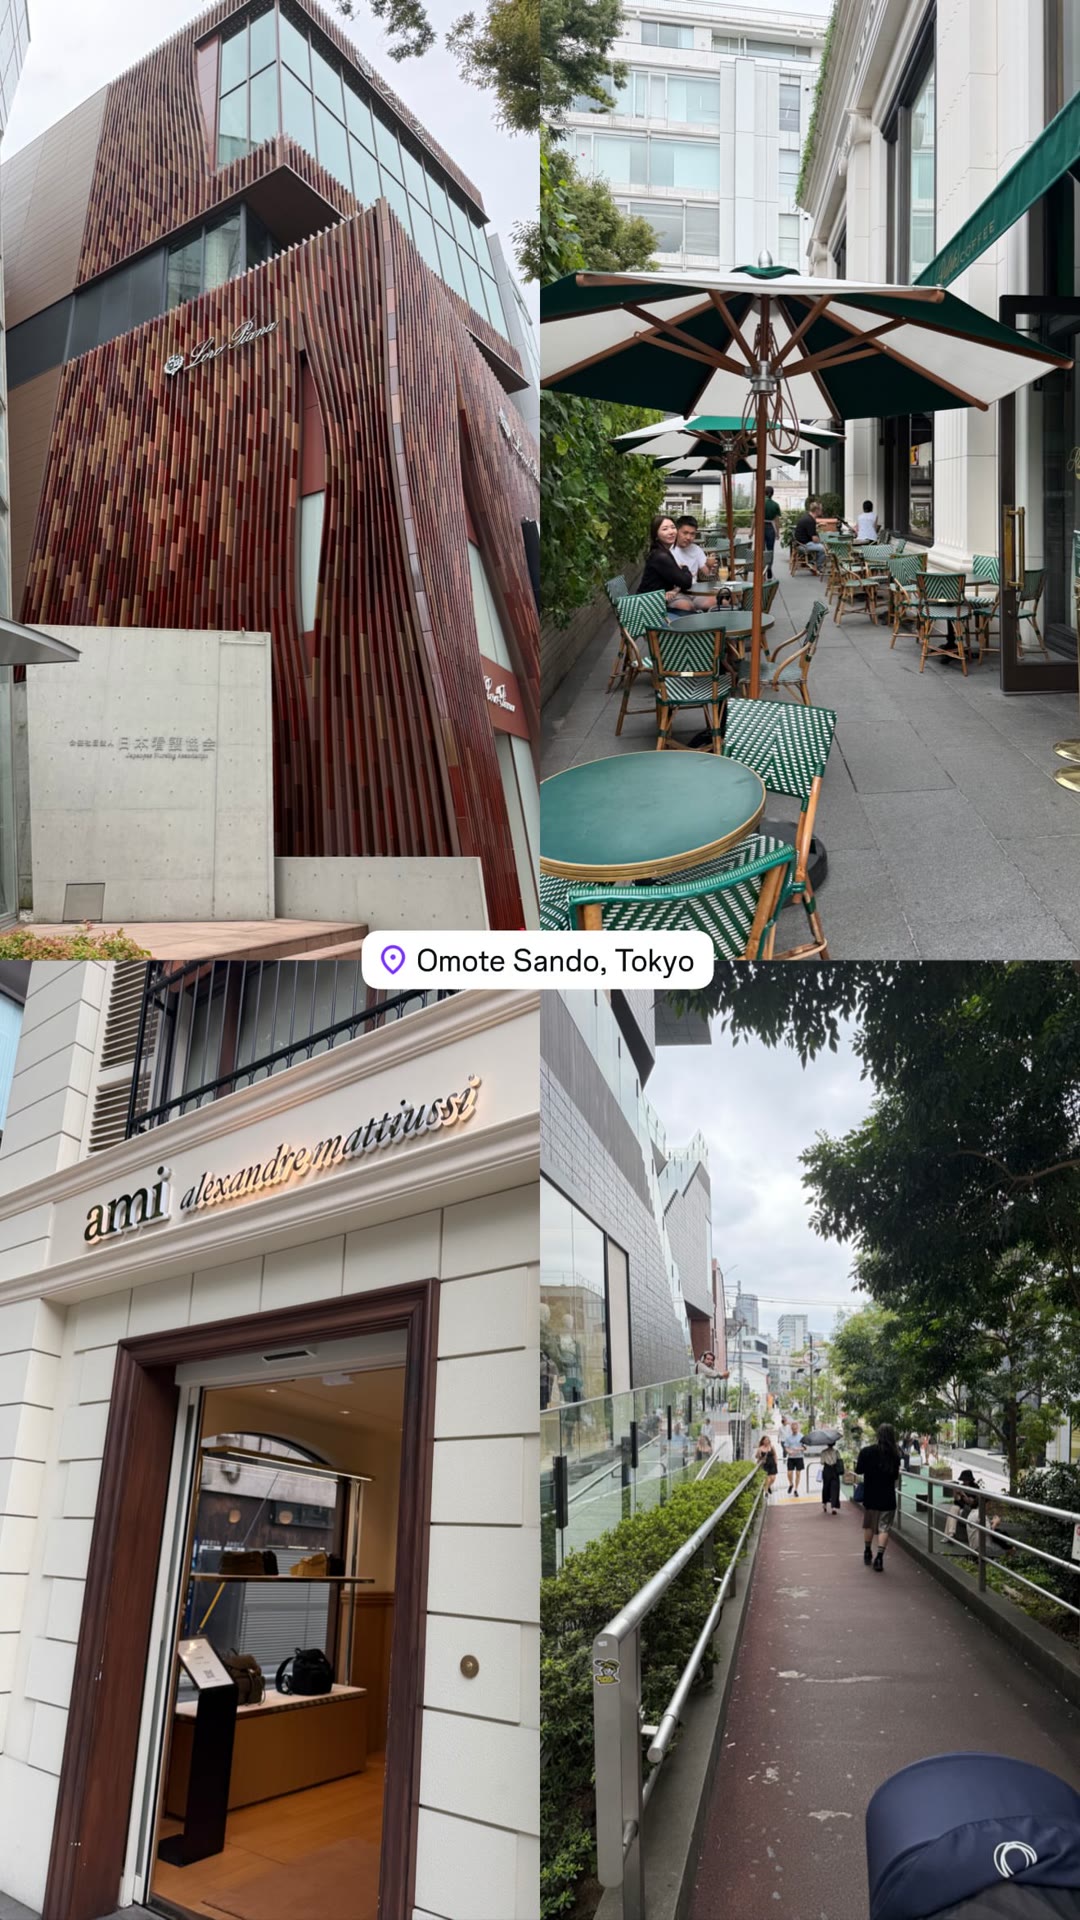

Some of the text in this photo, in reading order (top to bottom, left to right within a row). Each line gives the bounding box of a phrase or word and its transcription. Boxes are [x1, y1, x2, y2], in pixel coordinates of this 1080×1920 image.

[960, 219, 996, 263] COFFEE
[184, 315, 280, 370] Loro Piana
[84, 1073, 482, 1244] ami alexandre mattiussi
